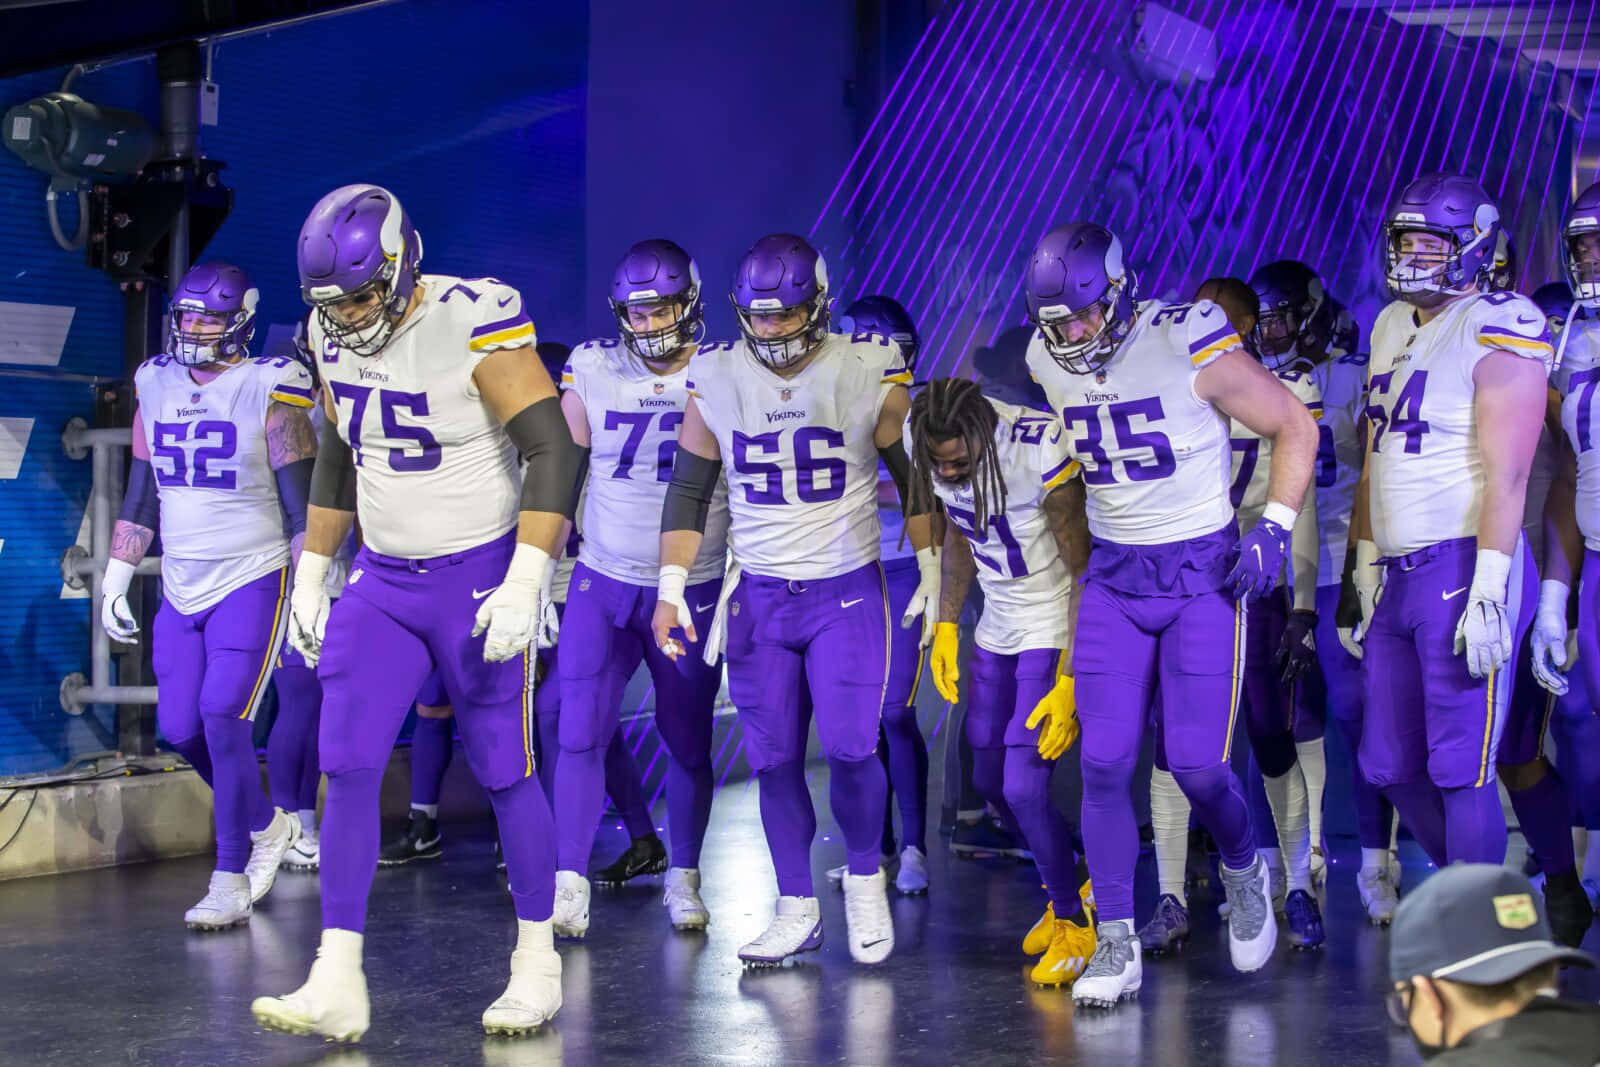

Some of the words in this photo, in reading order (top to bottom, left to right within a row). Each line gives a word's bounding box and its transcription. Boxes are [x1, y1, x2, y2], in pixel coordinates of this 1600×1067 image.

[153, 420, 237, 489] 52
[329, 380, 442, 472] 75
[604, 410, 685, 482] 72
[732, 426, 847, 505] 56
[1063, 396, 1176, 485] 35
